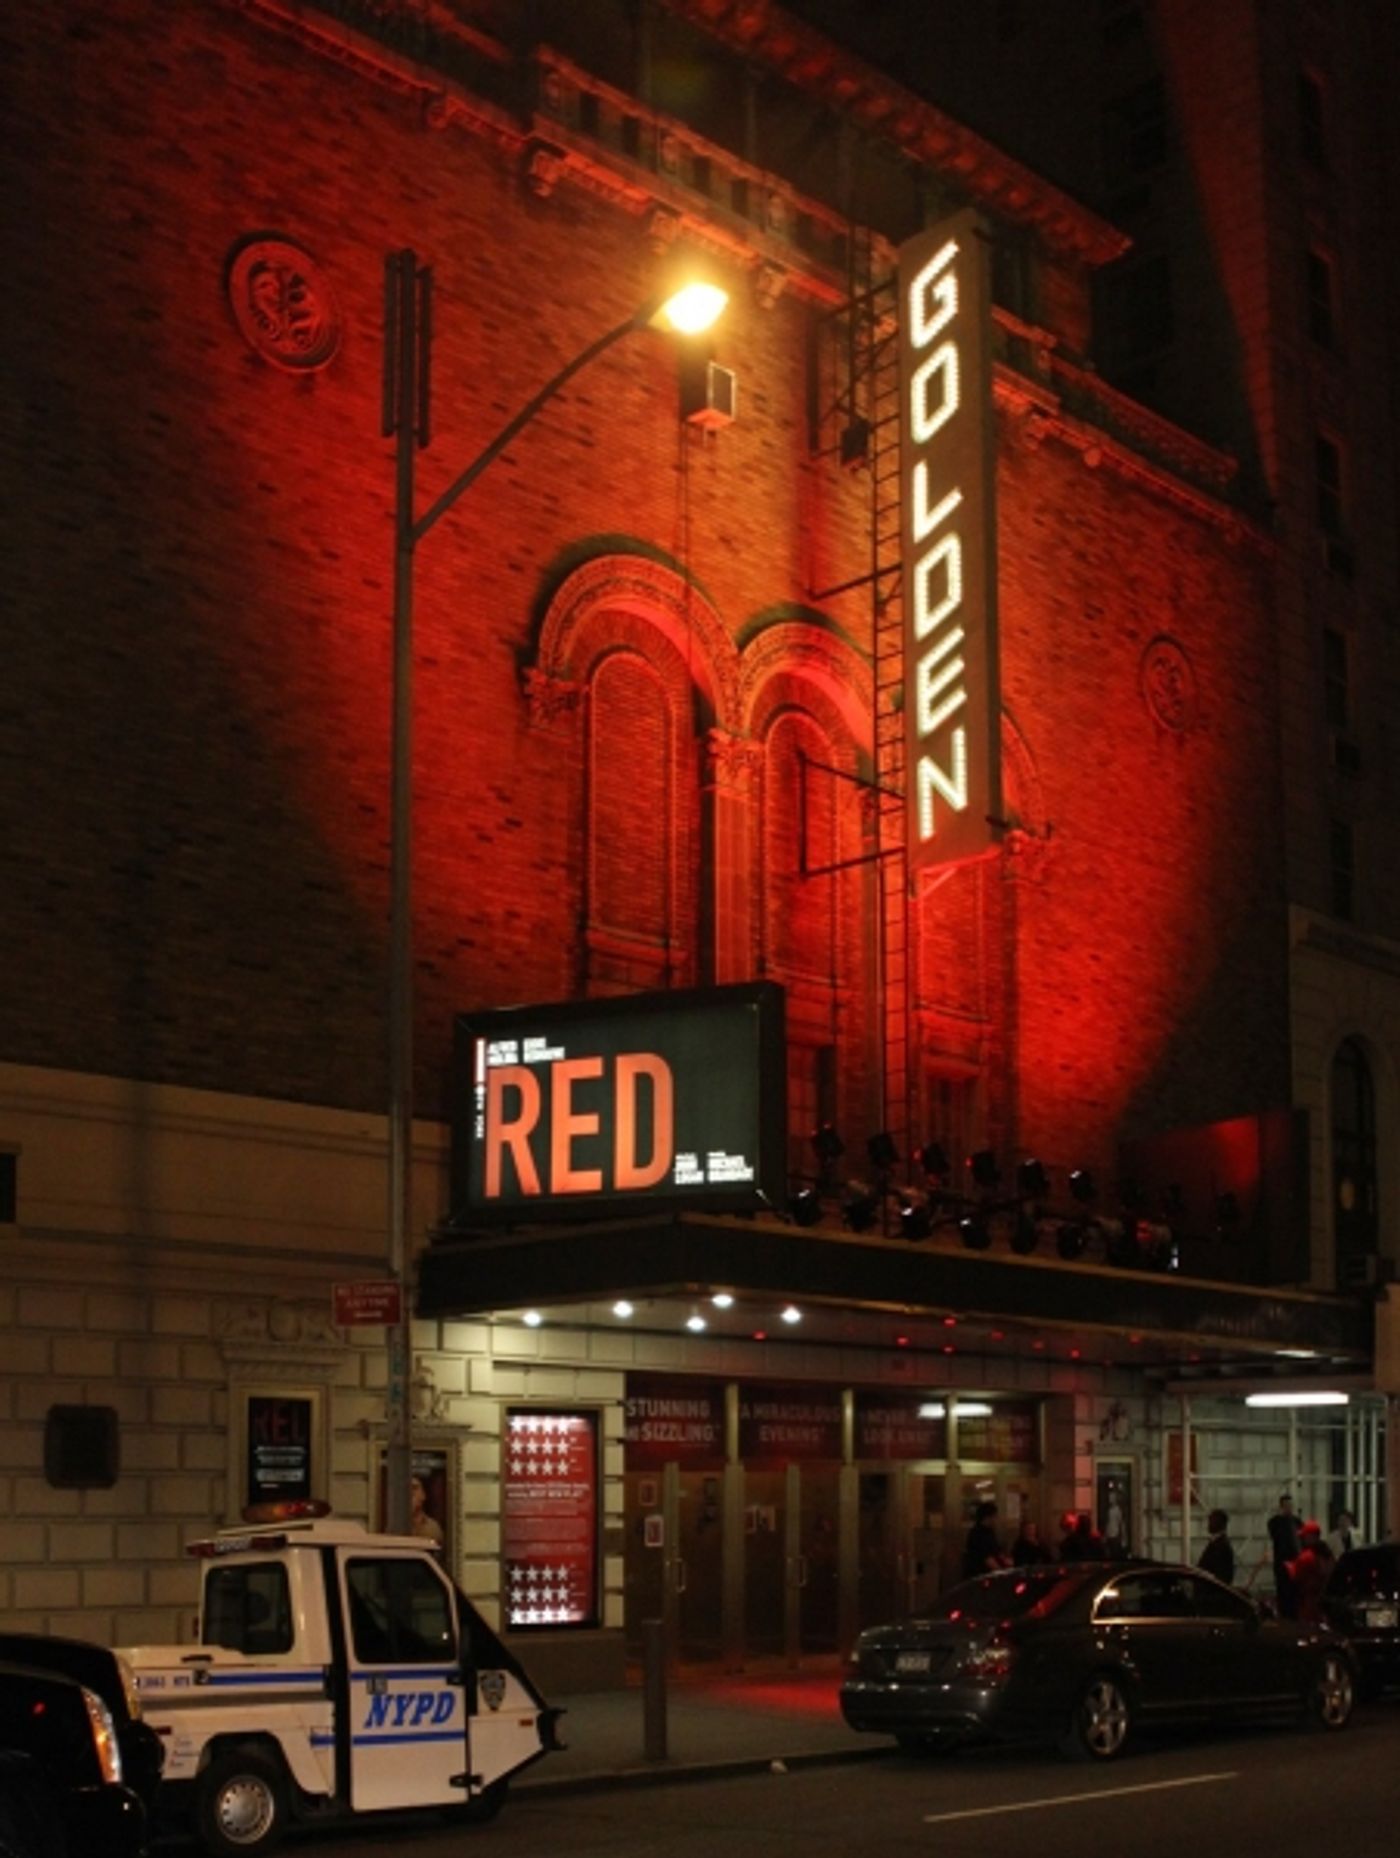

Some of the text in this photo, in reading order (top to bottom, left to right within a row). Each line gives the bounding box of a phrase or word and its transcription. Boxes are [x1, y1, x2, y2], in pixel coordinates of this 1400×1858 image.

[910, 240, 968, 841] GOLDEN
[484, 1052, 674, 1198] RED
[364, 1691, 456, 1728] NYPD
